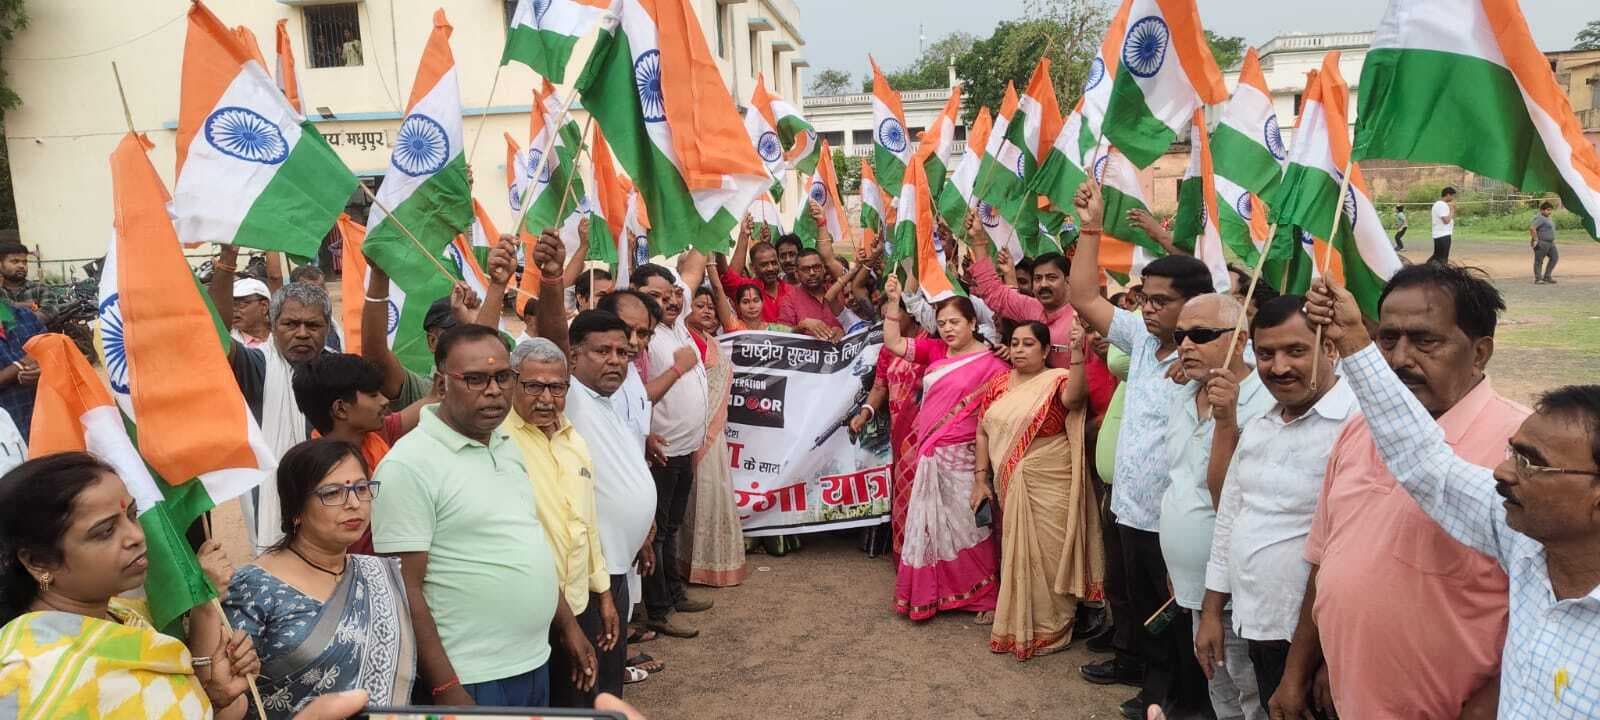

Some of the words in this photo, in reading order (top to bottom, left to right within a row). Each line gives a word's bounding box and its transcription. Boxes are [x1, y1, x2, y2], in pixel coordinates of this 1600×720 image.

[345, 132, 384, 151] मधुपुर
[741, 339, 785, 361] राष्ट्रीय
[787, 346, 820, 366] सुरक्षा
[823, 347, 840, 365] के
[743, 457, 756, 470] के
[733, 481, 807, 520] रंगा
[820, 463, 893, 503] यात्र
